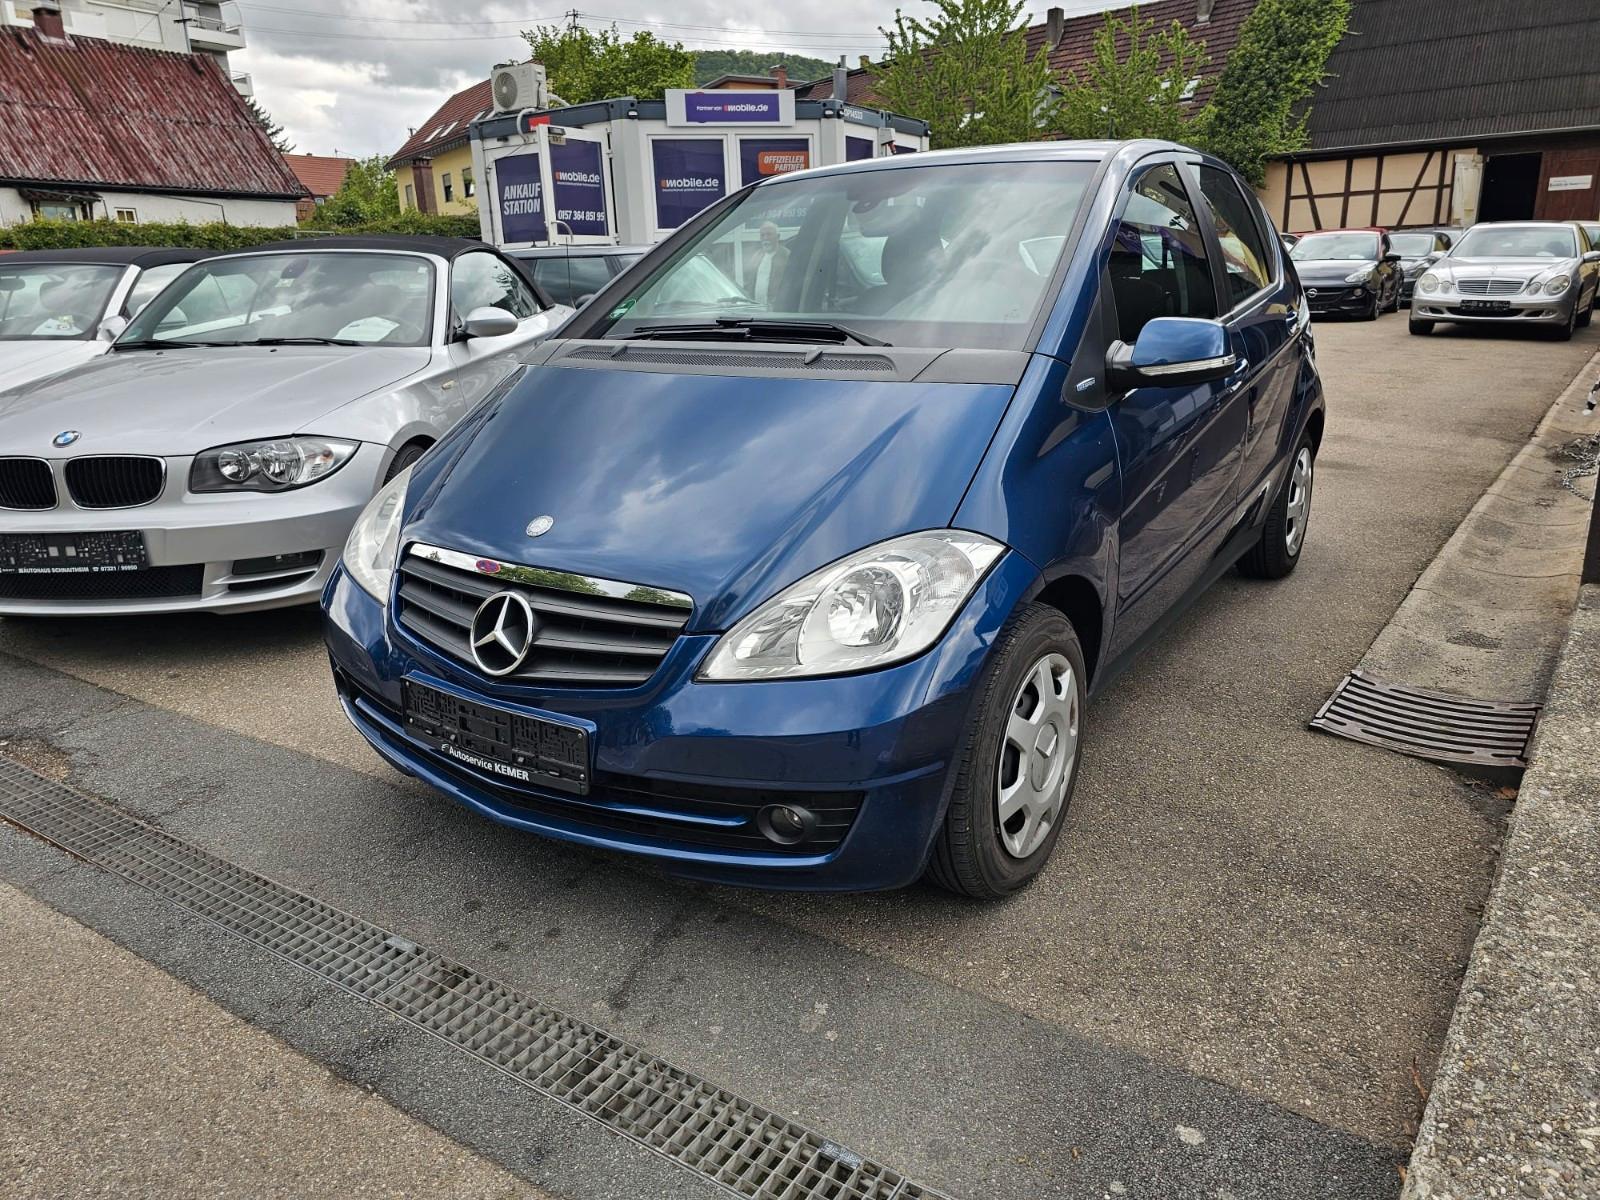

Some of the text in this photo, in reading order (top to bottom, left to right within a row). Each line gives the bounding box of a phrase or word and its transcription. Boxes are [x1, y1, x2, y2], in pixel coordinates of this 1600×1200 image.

[723, 104, 769, 112] mobile.de
[763, 155, 804, 164] OFFIZIELLER
[555, 171, 601, 183] mobile.de
[661, 178, 719, 188] mobile.de
[503, 183, 541, 200] ANKAUF
[503, 198, 541, 216] STATION
[557, 209, 605, 222] 0157 364 851 95
[449, 746, 530, 781] Autoservice KEMER
